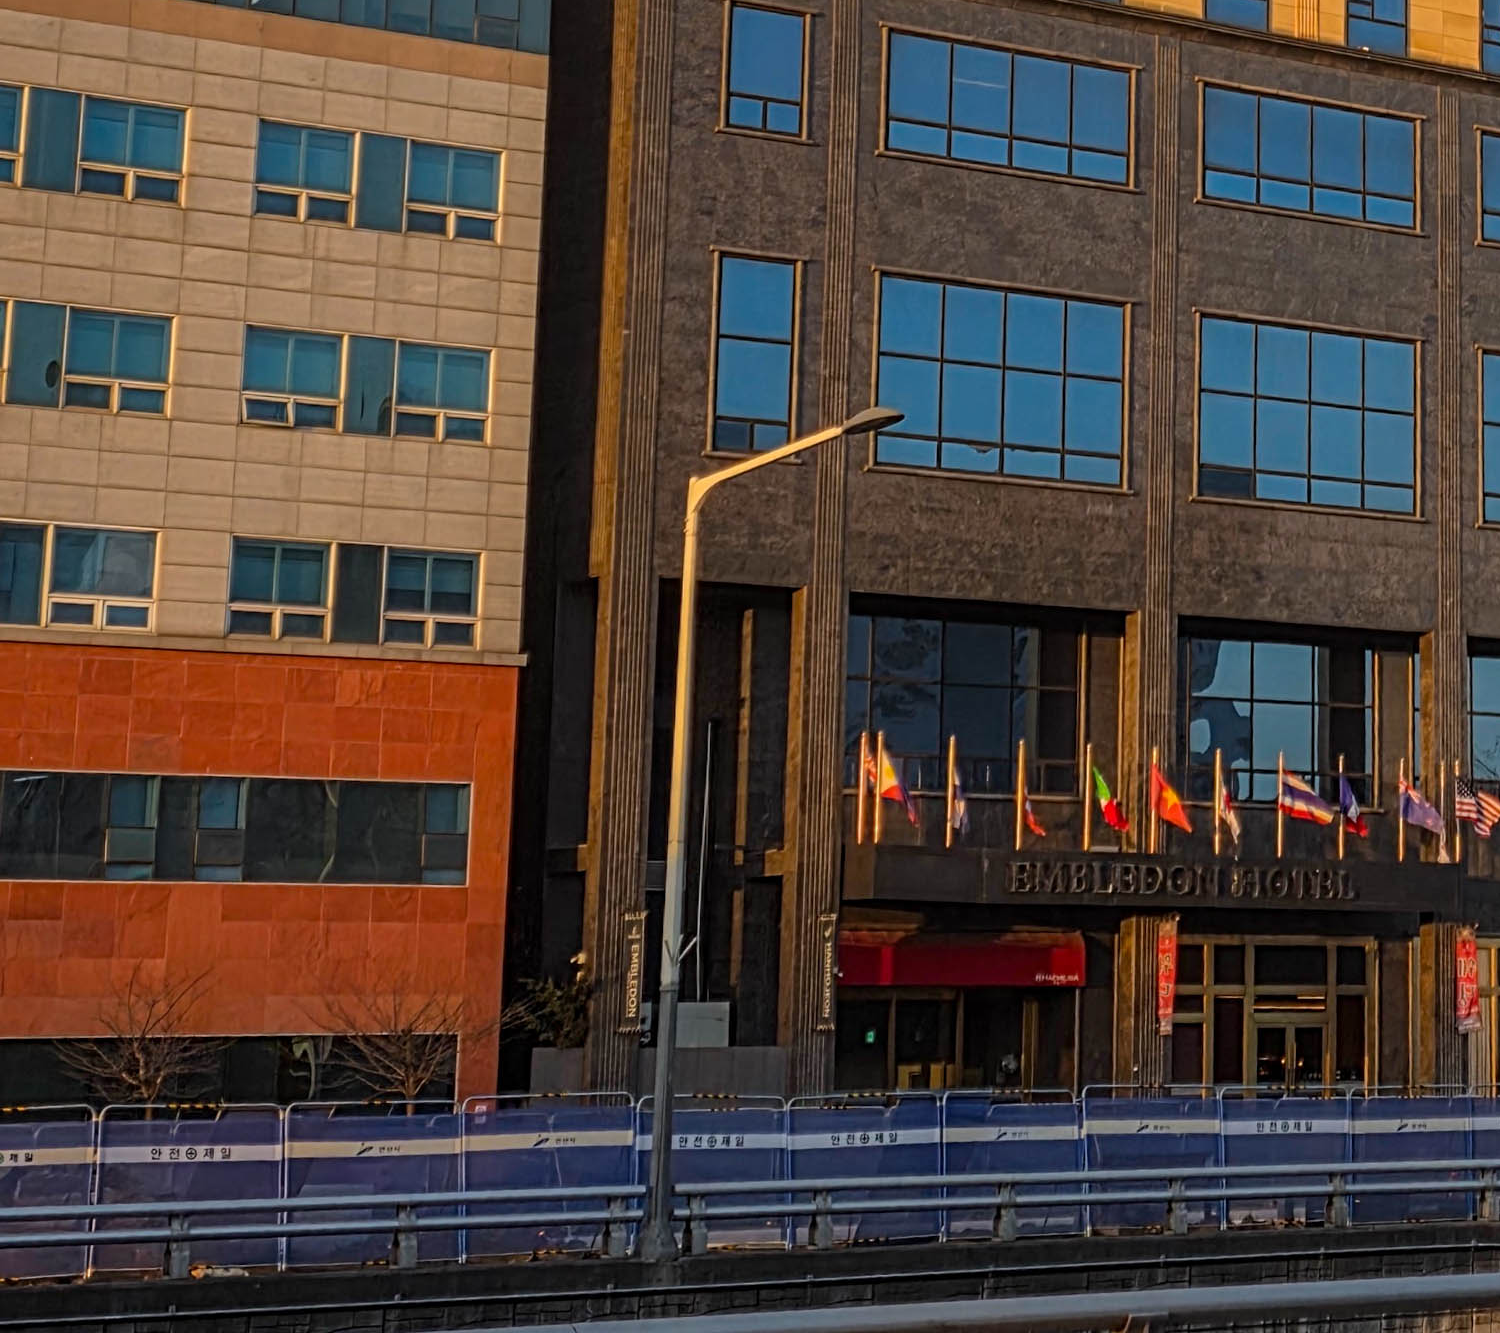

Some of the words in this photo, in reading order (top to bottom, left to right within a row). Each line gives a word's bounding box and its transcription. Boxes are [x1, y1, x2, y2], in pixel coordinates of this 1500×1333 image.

[1010, 861, 1221, 897] EMBLEDON
[1231, 866, 1357, 900] HOTEL
[628, 944, 640, 1018] EMBLEDON
